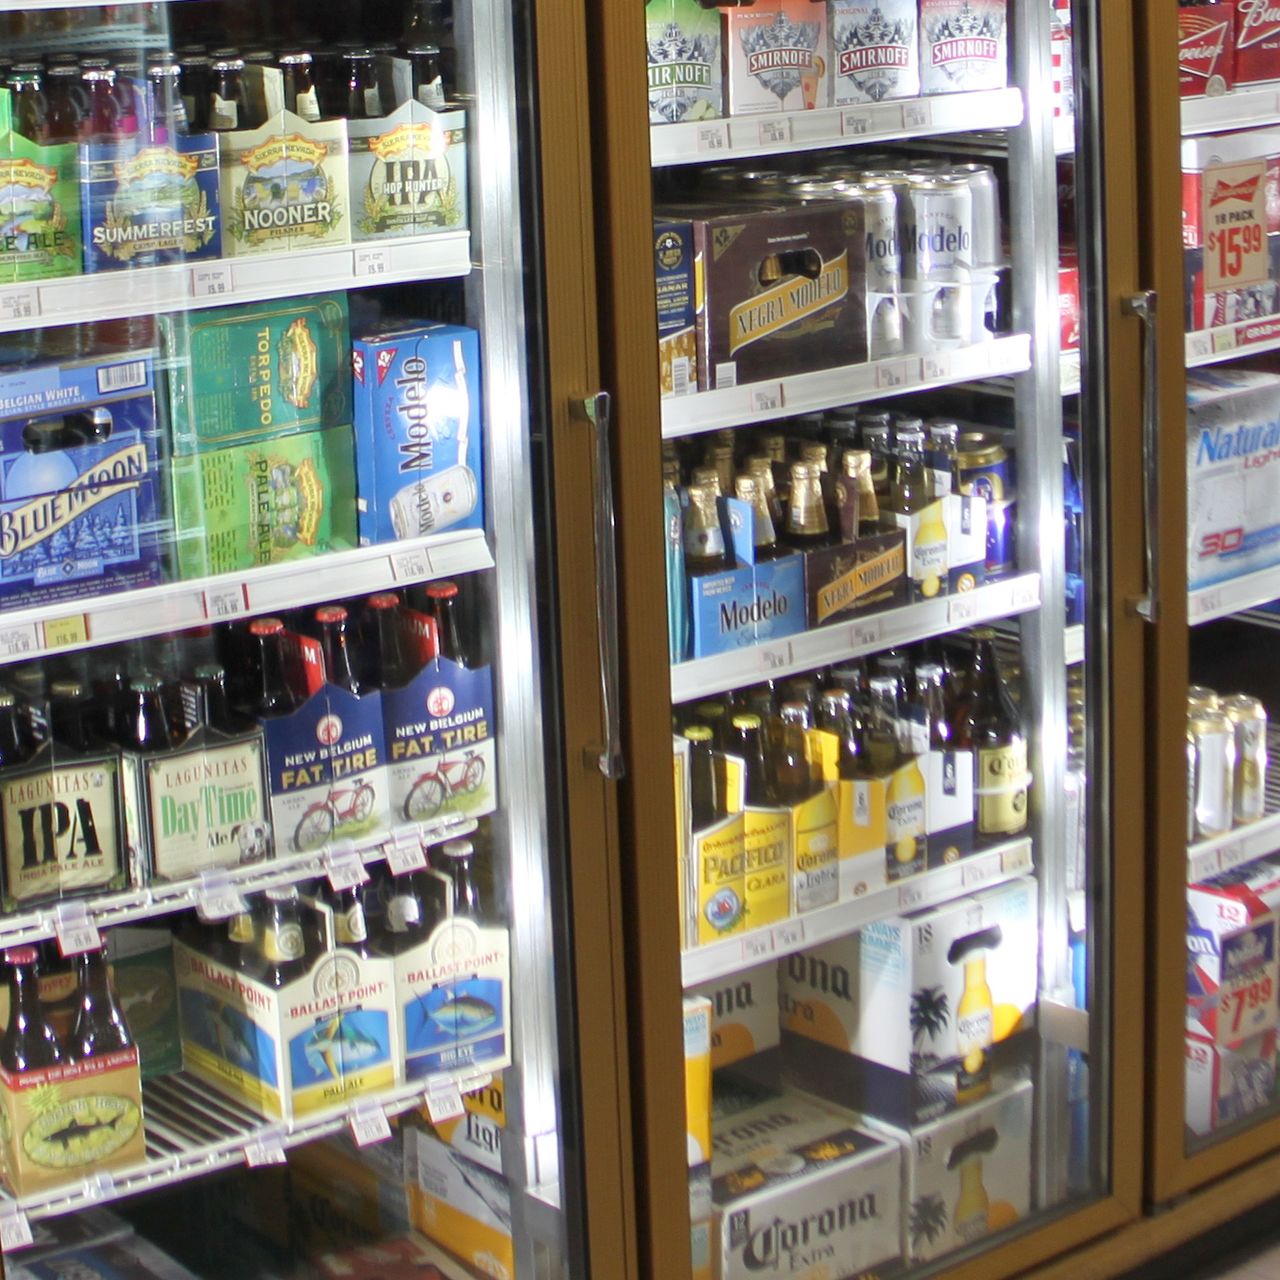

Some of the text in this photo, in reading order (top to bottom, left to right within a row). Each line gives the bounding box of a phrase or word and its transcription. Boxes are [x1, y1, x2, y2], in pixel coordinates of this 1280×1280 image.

[749, 49, 813, 72] SMIRNOFF
[840, 48, 910, 74] SMIRNOFF
[932, 37, 998, 62] SMIRNOFF
[405, 180, 443, 194] HUNTER
[92, 215, 216, 244] SUMMERFEST
[245, 201, 332, 230] NOONER
[1228, 209, 1256, 224] PACK
[25, 230, 66, 250] ALE
[736, 266, 842, 340] NEGRA MODELO
[46, 385, 81, 401] WHITE
[256, 326, 274, 426] TORPEDO
[396, 354, 434, 475] Modelo
[67, 451, 144, 514] MOON
[255, 458, 272, 563] PALE ALE
[1199, 527, 1244, 558] 30
[720, 592, 788, 636] Modelo
[391, 719, 489, 760] FAT TIRE
[395, 706, 485, 739] NEW BELGIUM
[284, 733, 374, 769] NEW BELGIUM
[164, 756, 249, 789] LAGUNITAS
[279, 750, 378, 790] FAT TIRE
[8, 772, 92, 806] LAGUNITAS
[18, 797, 104, 871] IPA
[406, 951, 502, 986] BALLAST POINT
[238, 982, 273, 1013] POINT
[289, 981, 385, 1020] BALLAST POINT
[741, 1190, 879, 1273] Corona
